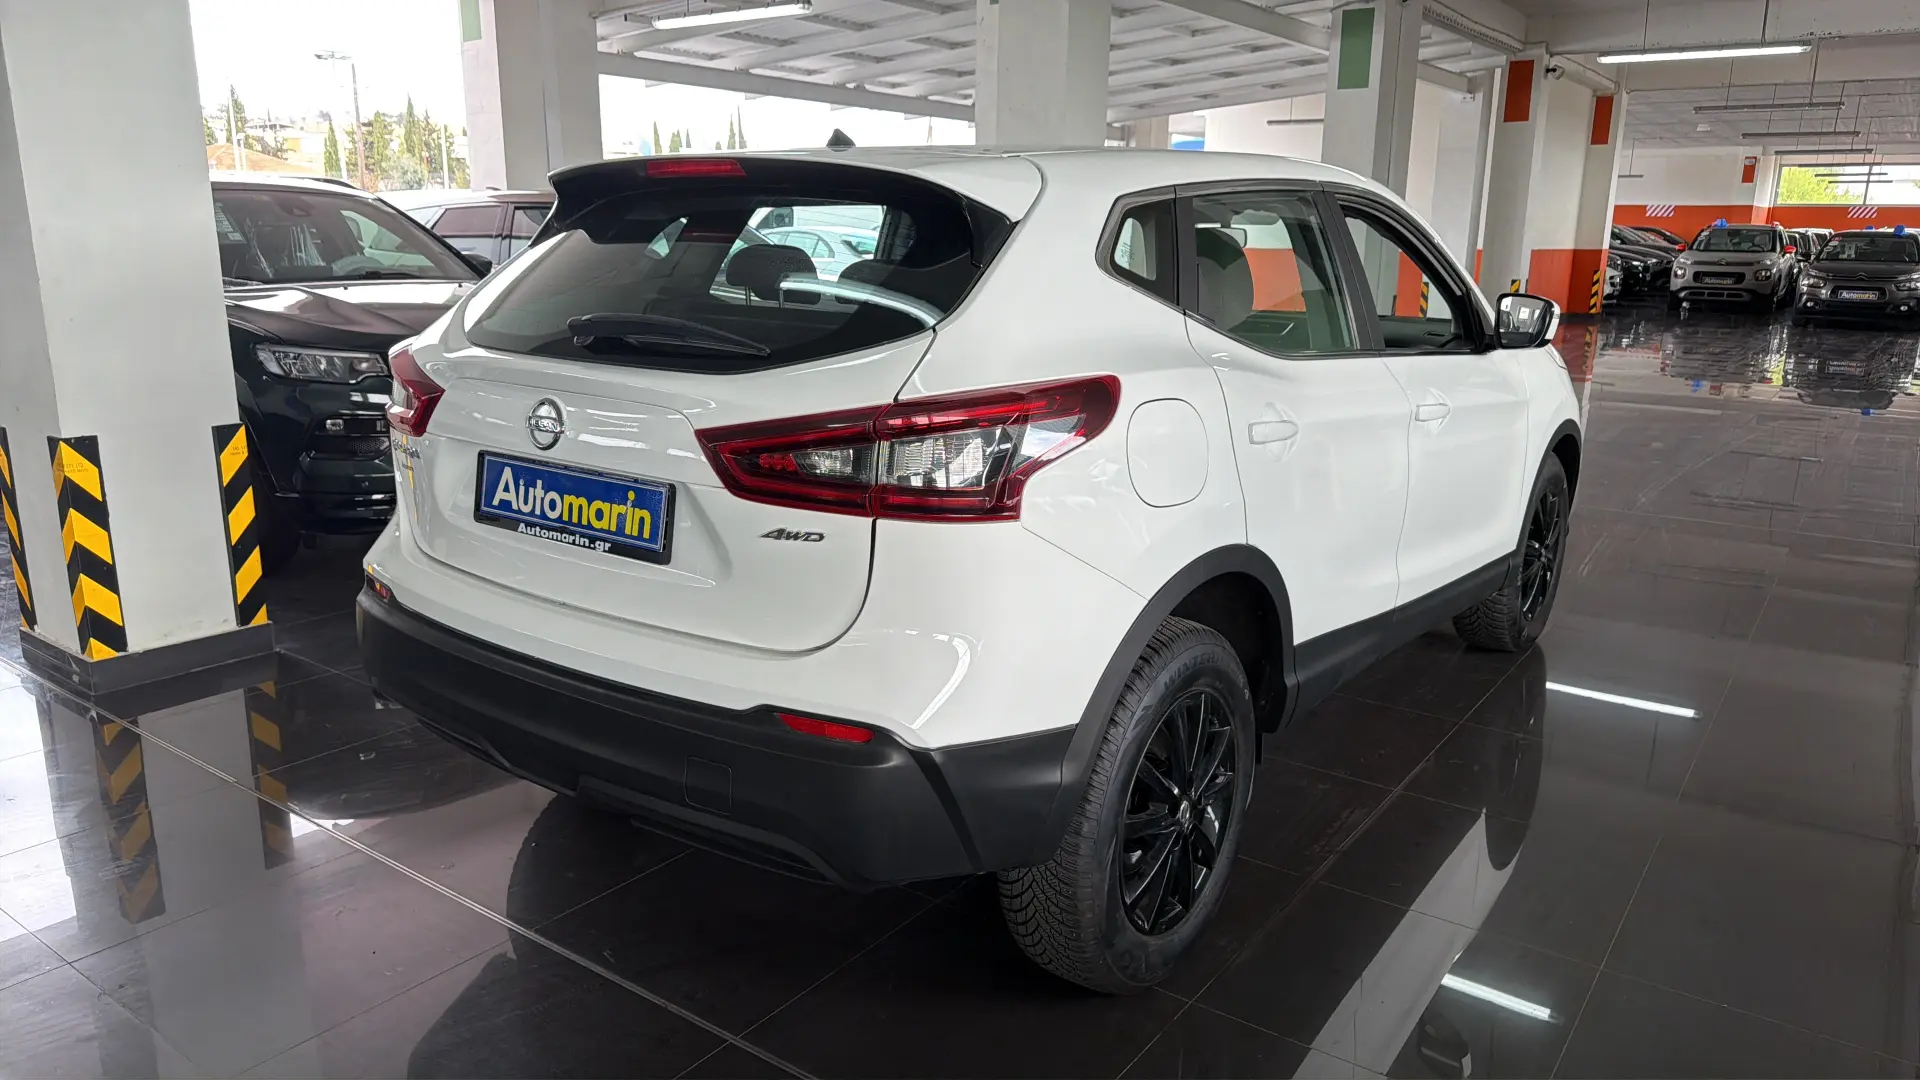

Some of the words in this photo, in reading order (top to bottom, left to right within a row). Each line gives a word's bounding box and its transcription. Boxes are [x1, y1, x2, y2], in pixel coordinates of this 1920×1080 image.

[492, 466, 652, 539] Automarin
[517, 522, 612, 552] Automarin.gr
[760, 527, 826, 542] 4WD
